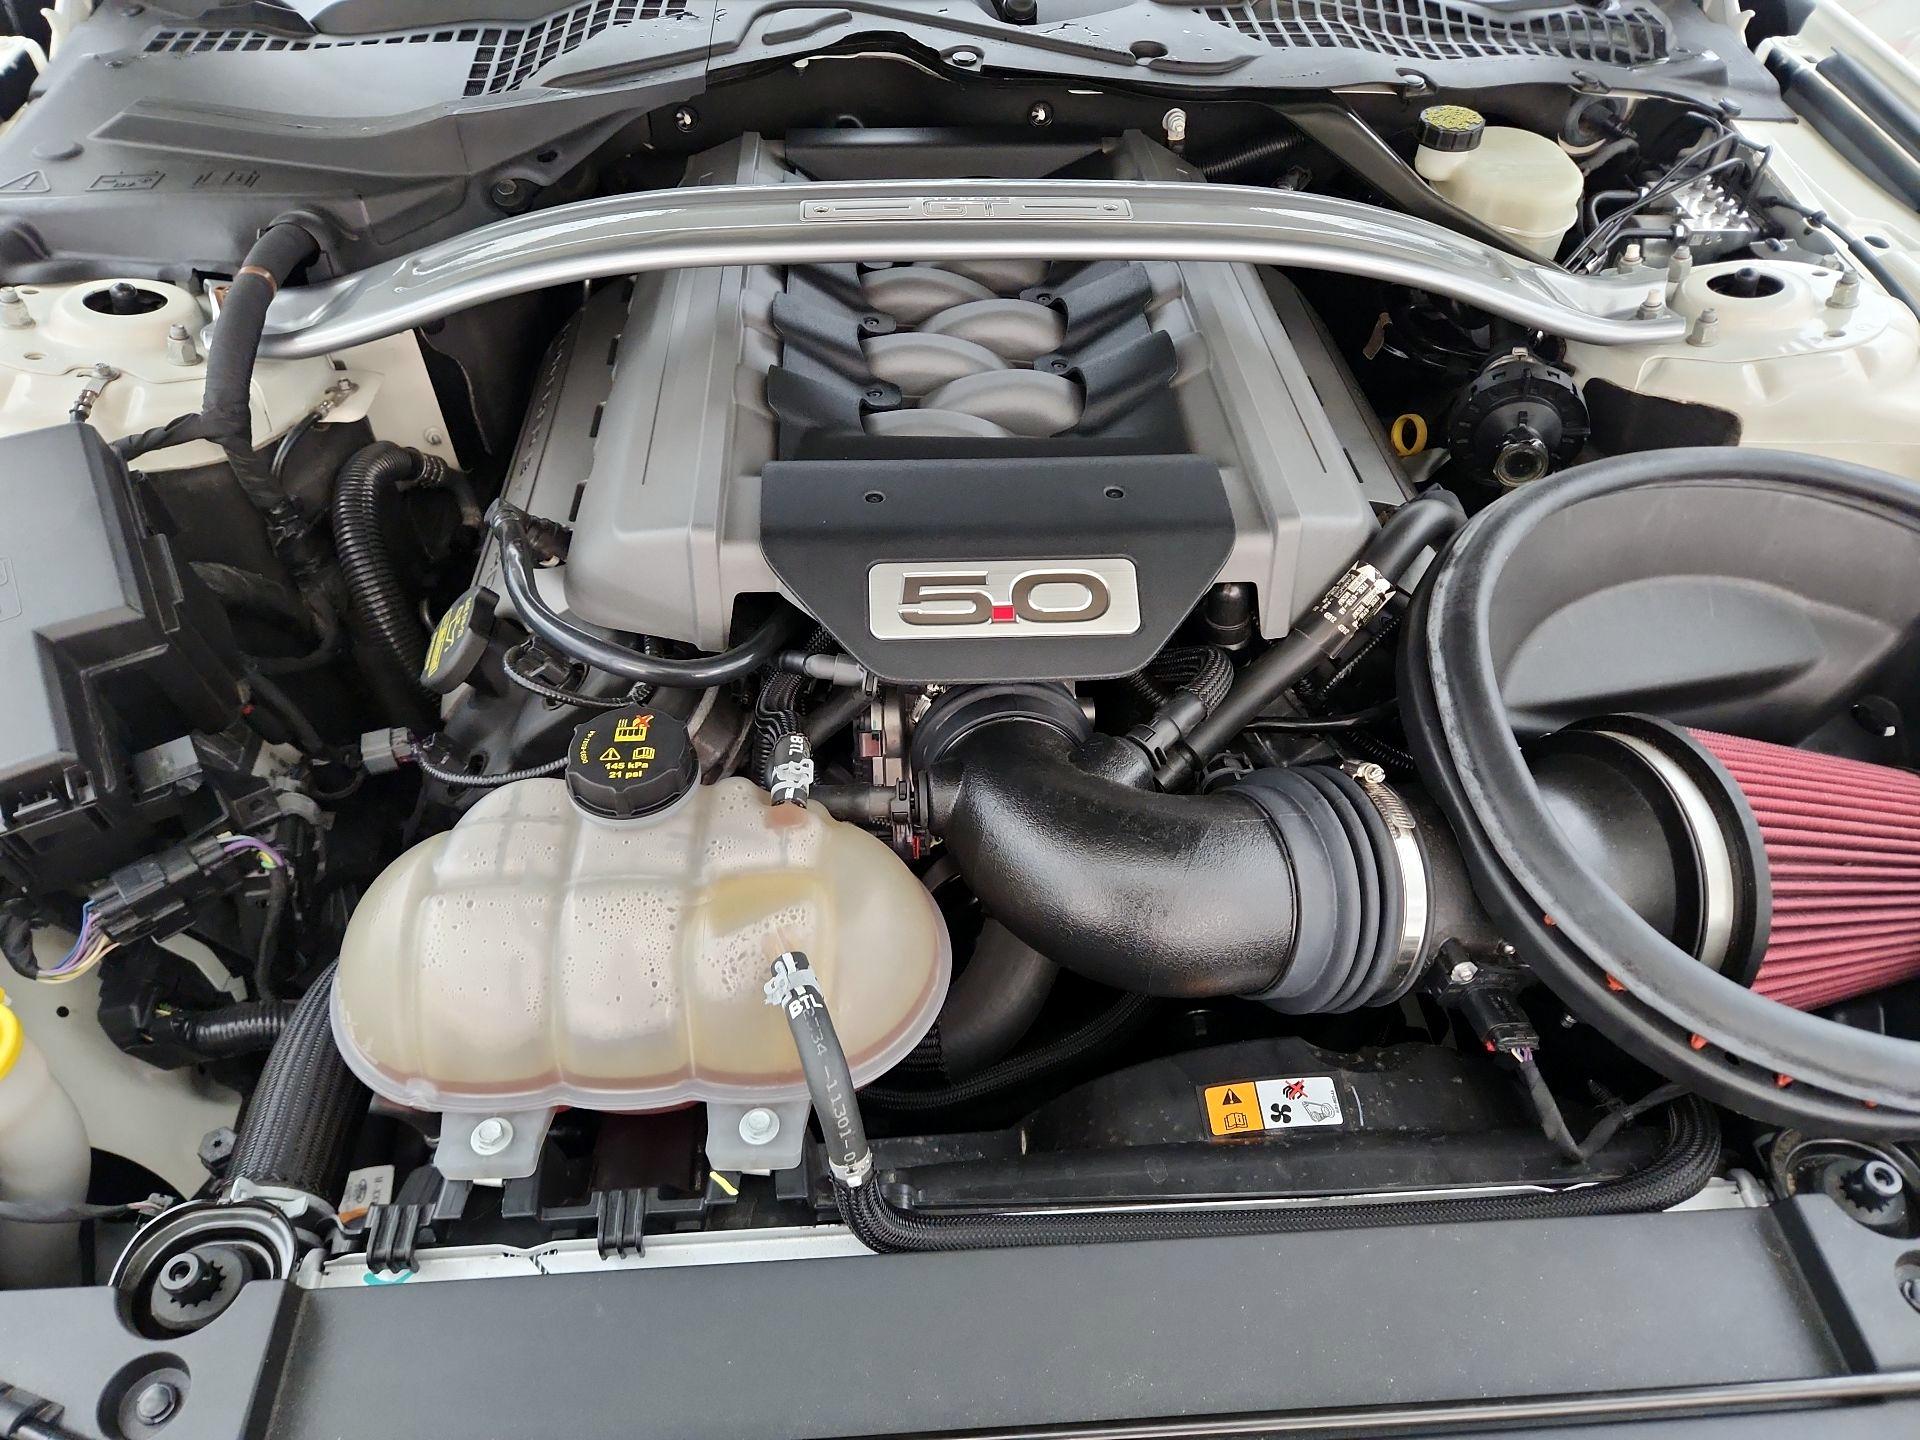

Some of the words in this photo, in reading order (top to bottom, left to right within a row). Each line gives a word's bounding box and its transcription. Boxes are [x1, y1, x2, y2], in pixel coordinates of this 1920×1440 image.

[922, 197, 1011, 217] GT
[897, 569, 1111, 626] 5.0
[788, 735, 804, 756] BTL
[604, 762, 625, 770] 145
[627, 761, 649, 769] kPa
[608, 770, 622, 779] 21
[625, 770, 643, 779] psi
[788, 993, 824, 1020] BTL
